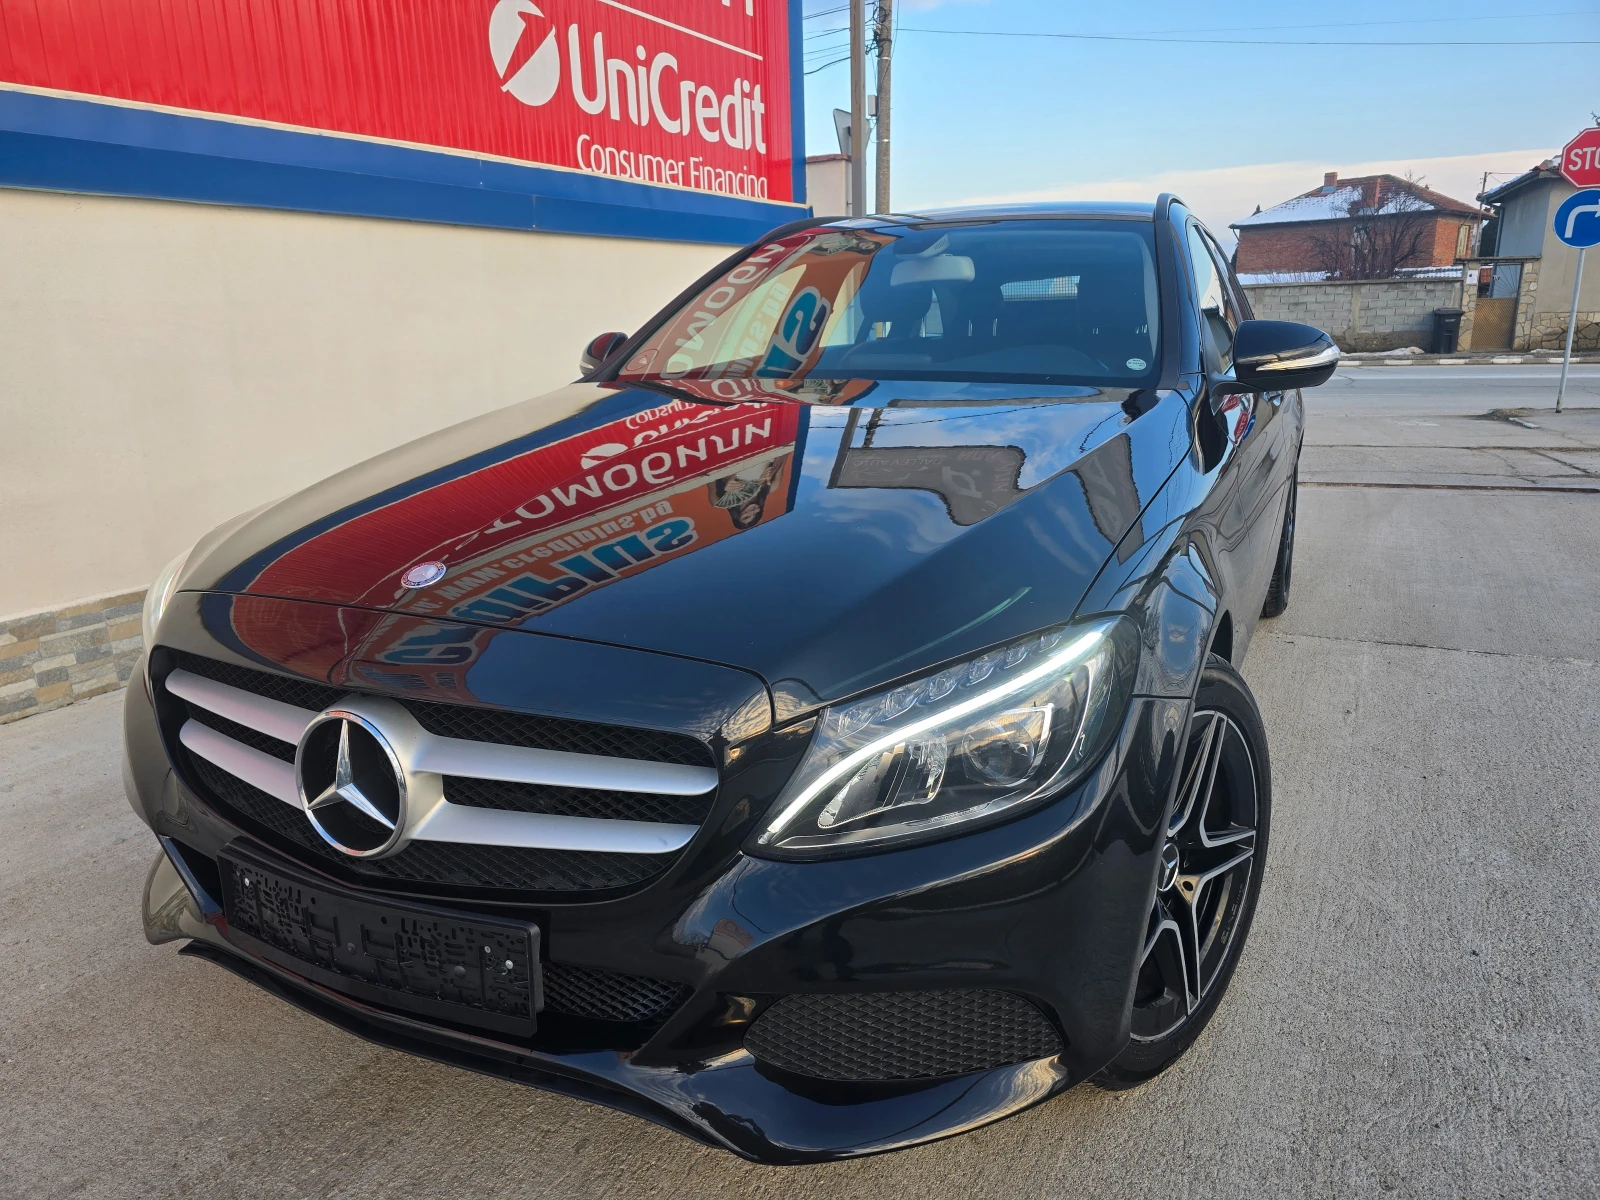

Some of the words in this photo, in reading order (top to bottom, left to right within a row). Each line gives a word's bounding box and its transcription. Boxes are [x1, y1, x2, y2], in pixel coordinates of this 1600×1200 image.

[568, 23, 766, 155] UniCredit
[576, 134, 685, 186] Consumer
[690, 156, 768, 199] Financing
